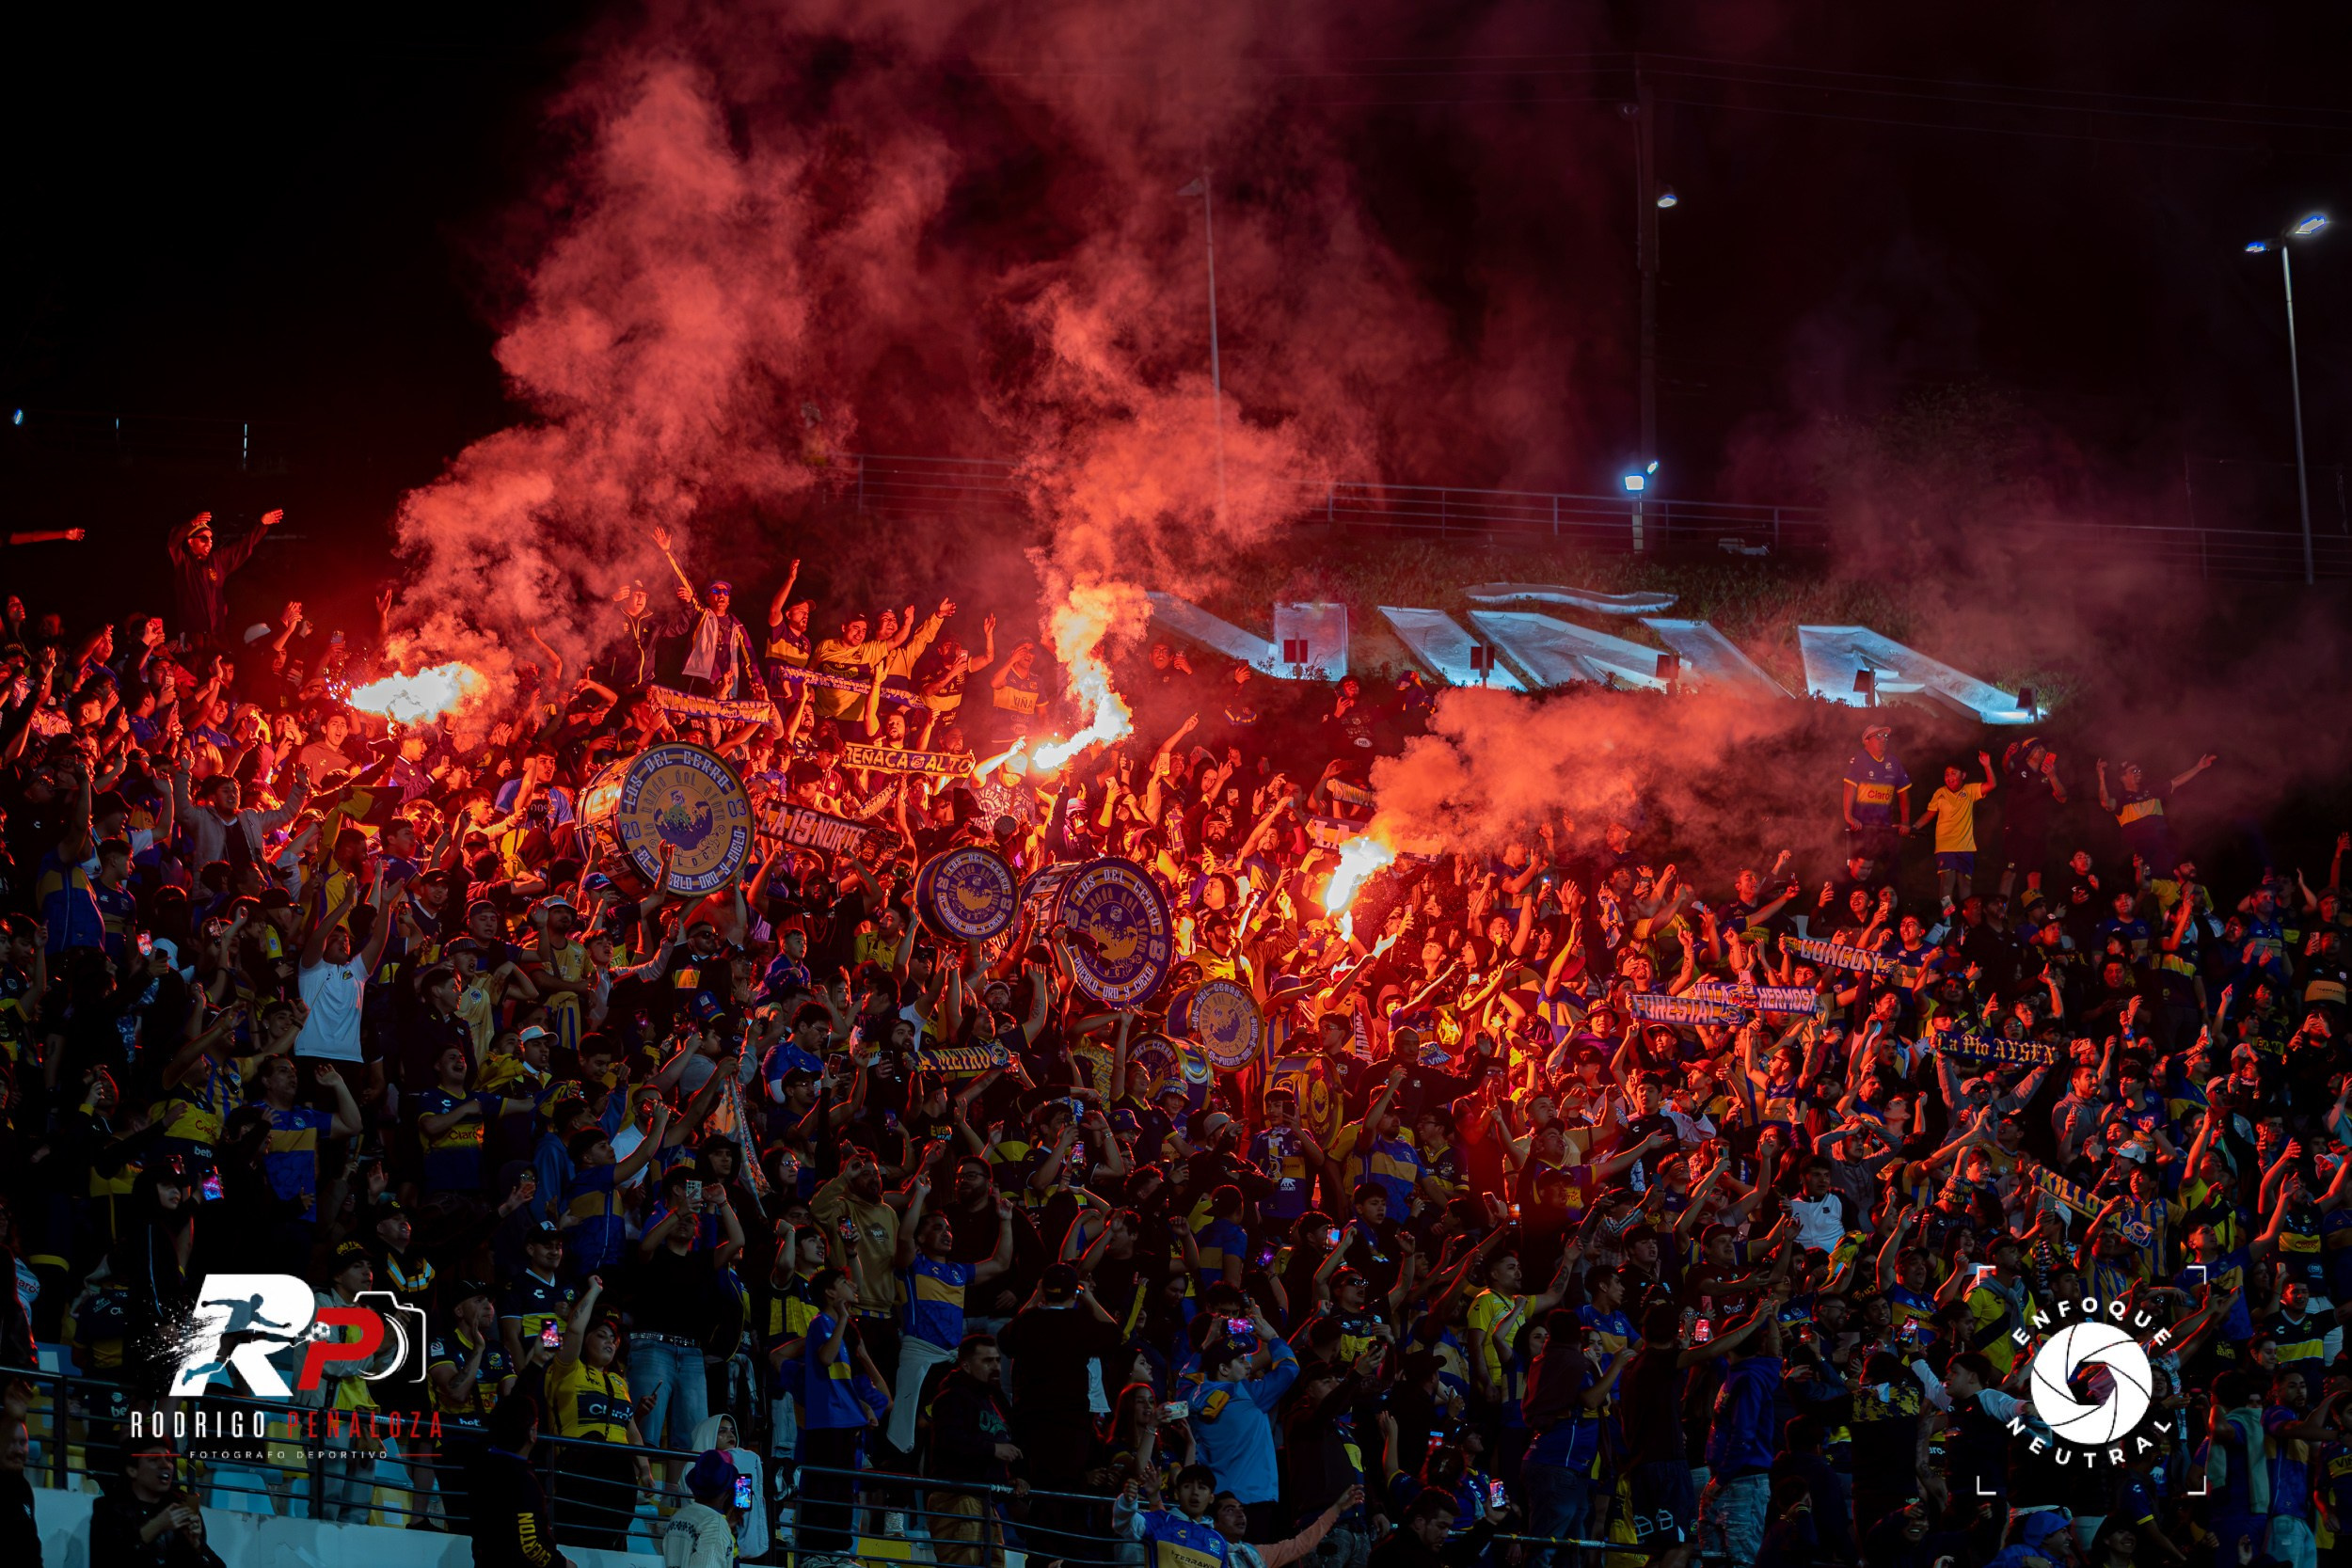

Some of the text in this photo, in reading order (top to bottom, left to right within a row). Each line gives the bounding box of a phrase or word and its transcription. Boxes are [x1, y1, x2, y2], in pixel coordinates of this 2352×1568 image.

[1013, 696, 1034, 710] VIÑA
[844, 746, 974, 773] REÑACA ALTO
[624, 751, 729, 807] LOS DEL CERRO
[726, 799, 747, 817] 03
[622, 821, 641, 840] 20
[760, 802, 787, 836] LA
[786, 808, 818, 845] 19
[811, 816, 867, 854] NORTE
[637, 830, 746, 890] EL PEBLO ORO Y CIELO
[946, 853, 1010, 890] LOS DEL CERRO
[936, 876, 1012, 911] 20 03
[1074, 868, 1161, 927] LOS DEL CERRO
[944, 907, 962, 928] PUEBLO
[965, 925, 977, 934] ORO
[988, 913, 1004, 928] CIELO
[1063, 907, 1080, 929] 20
[1148, 940, 1166, 961] 03
[1073, 958, 1099, 992] PUEBLO
[1103, 985, 1120, 1000] ORO
[1123, 985, 1131, 1000] Y
[1133, 965, 1154, 992] CIELO
[1197, 990, 1211, 1005] DEL
[1214, 983, 1239, 998] CERRO
[1694, 983, 1818, 1012] VILLA HERMOSA
[1633, 995, 1720, 1024] FORESTAL
[931, 1045, 992, 1070] METRO
[1152, 1040, 1173, 1058] CERRO
[1218, 1056, 1241, 1067] PUEBLO
[2040, 1169, 2124, 1230] KILLOA
[517, 1513, 551, 1567] EVERTON
